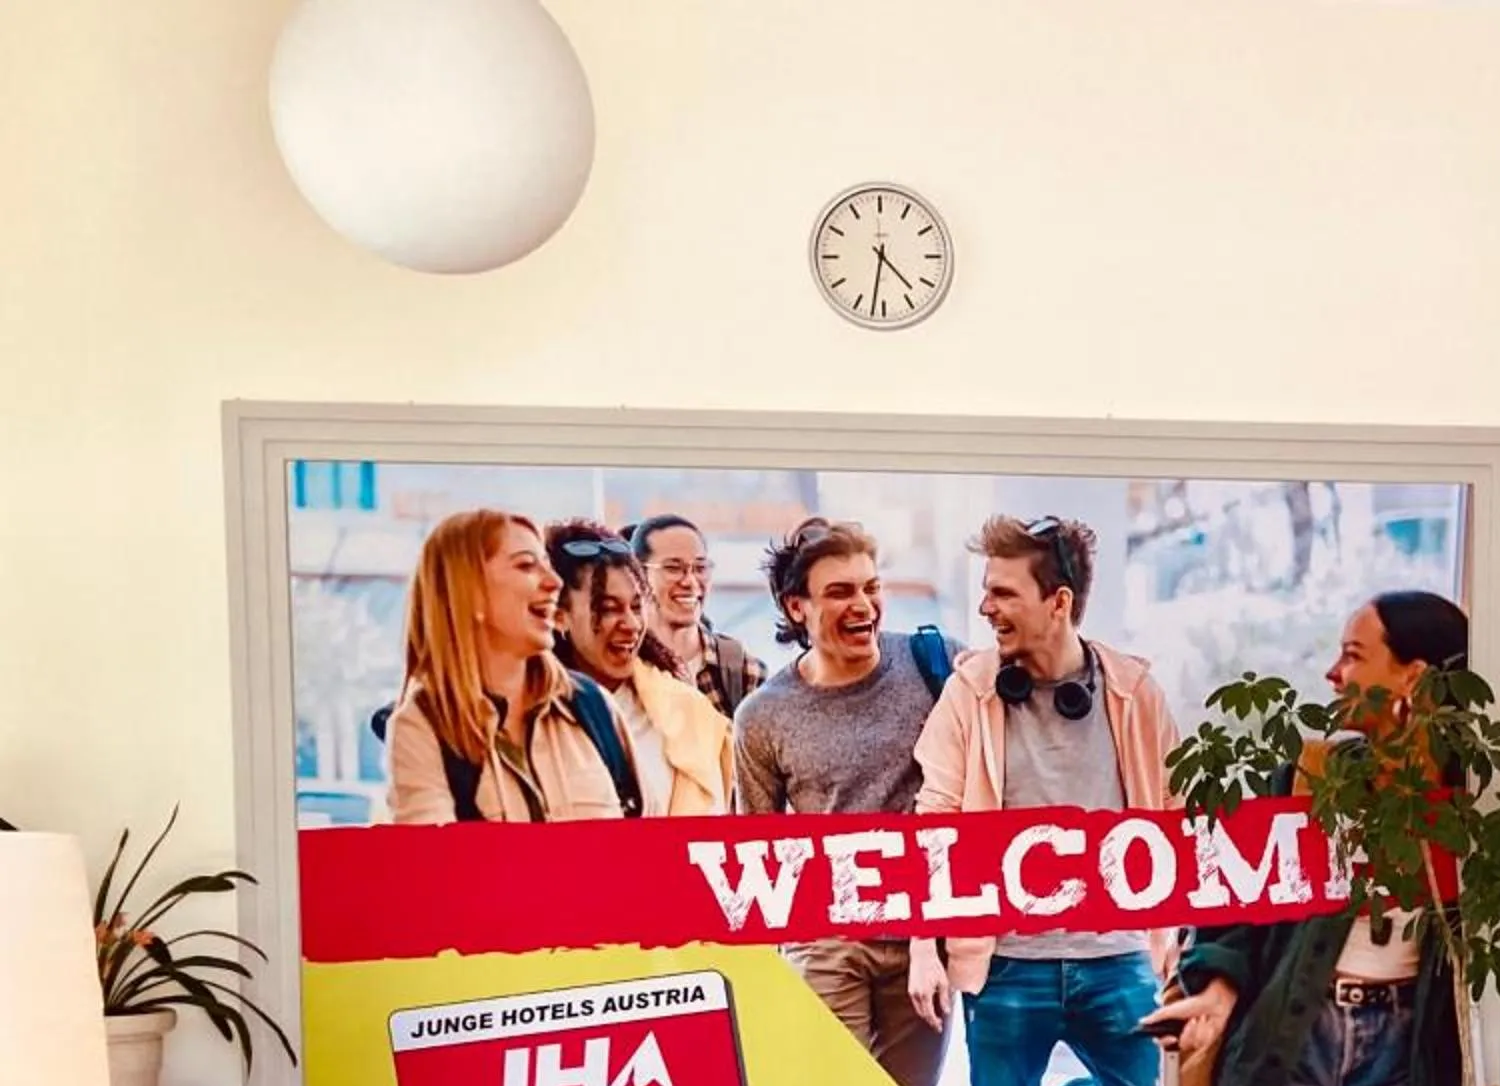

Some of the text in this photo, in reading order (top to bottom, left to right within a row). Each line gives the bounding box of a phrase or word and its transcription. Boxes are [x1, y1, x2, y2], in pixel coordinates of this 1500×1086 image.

[411, 985, 706, 1038] JUNGE HOTELS AUSTRIA
